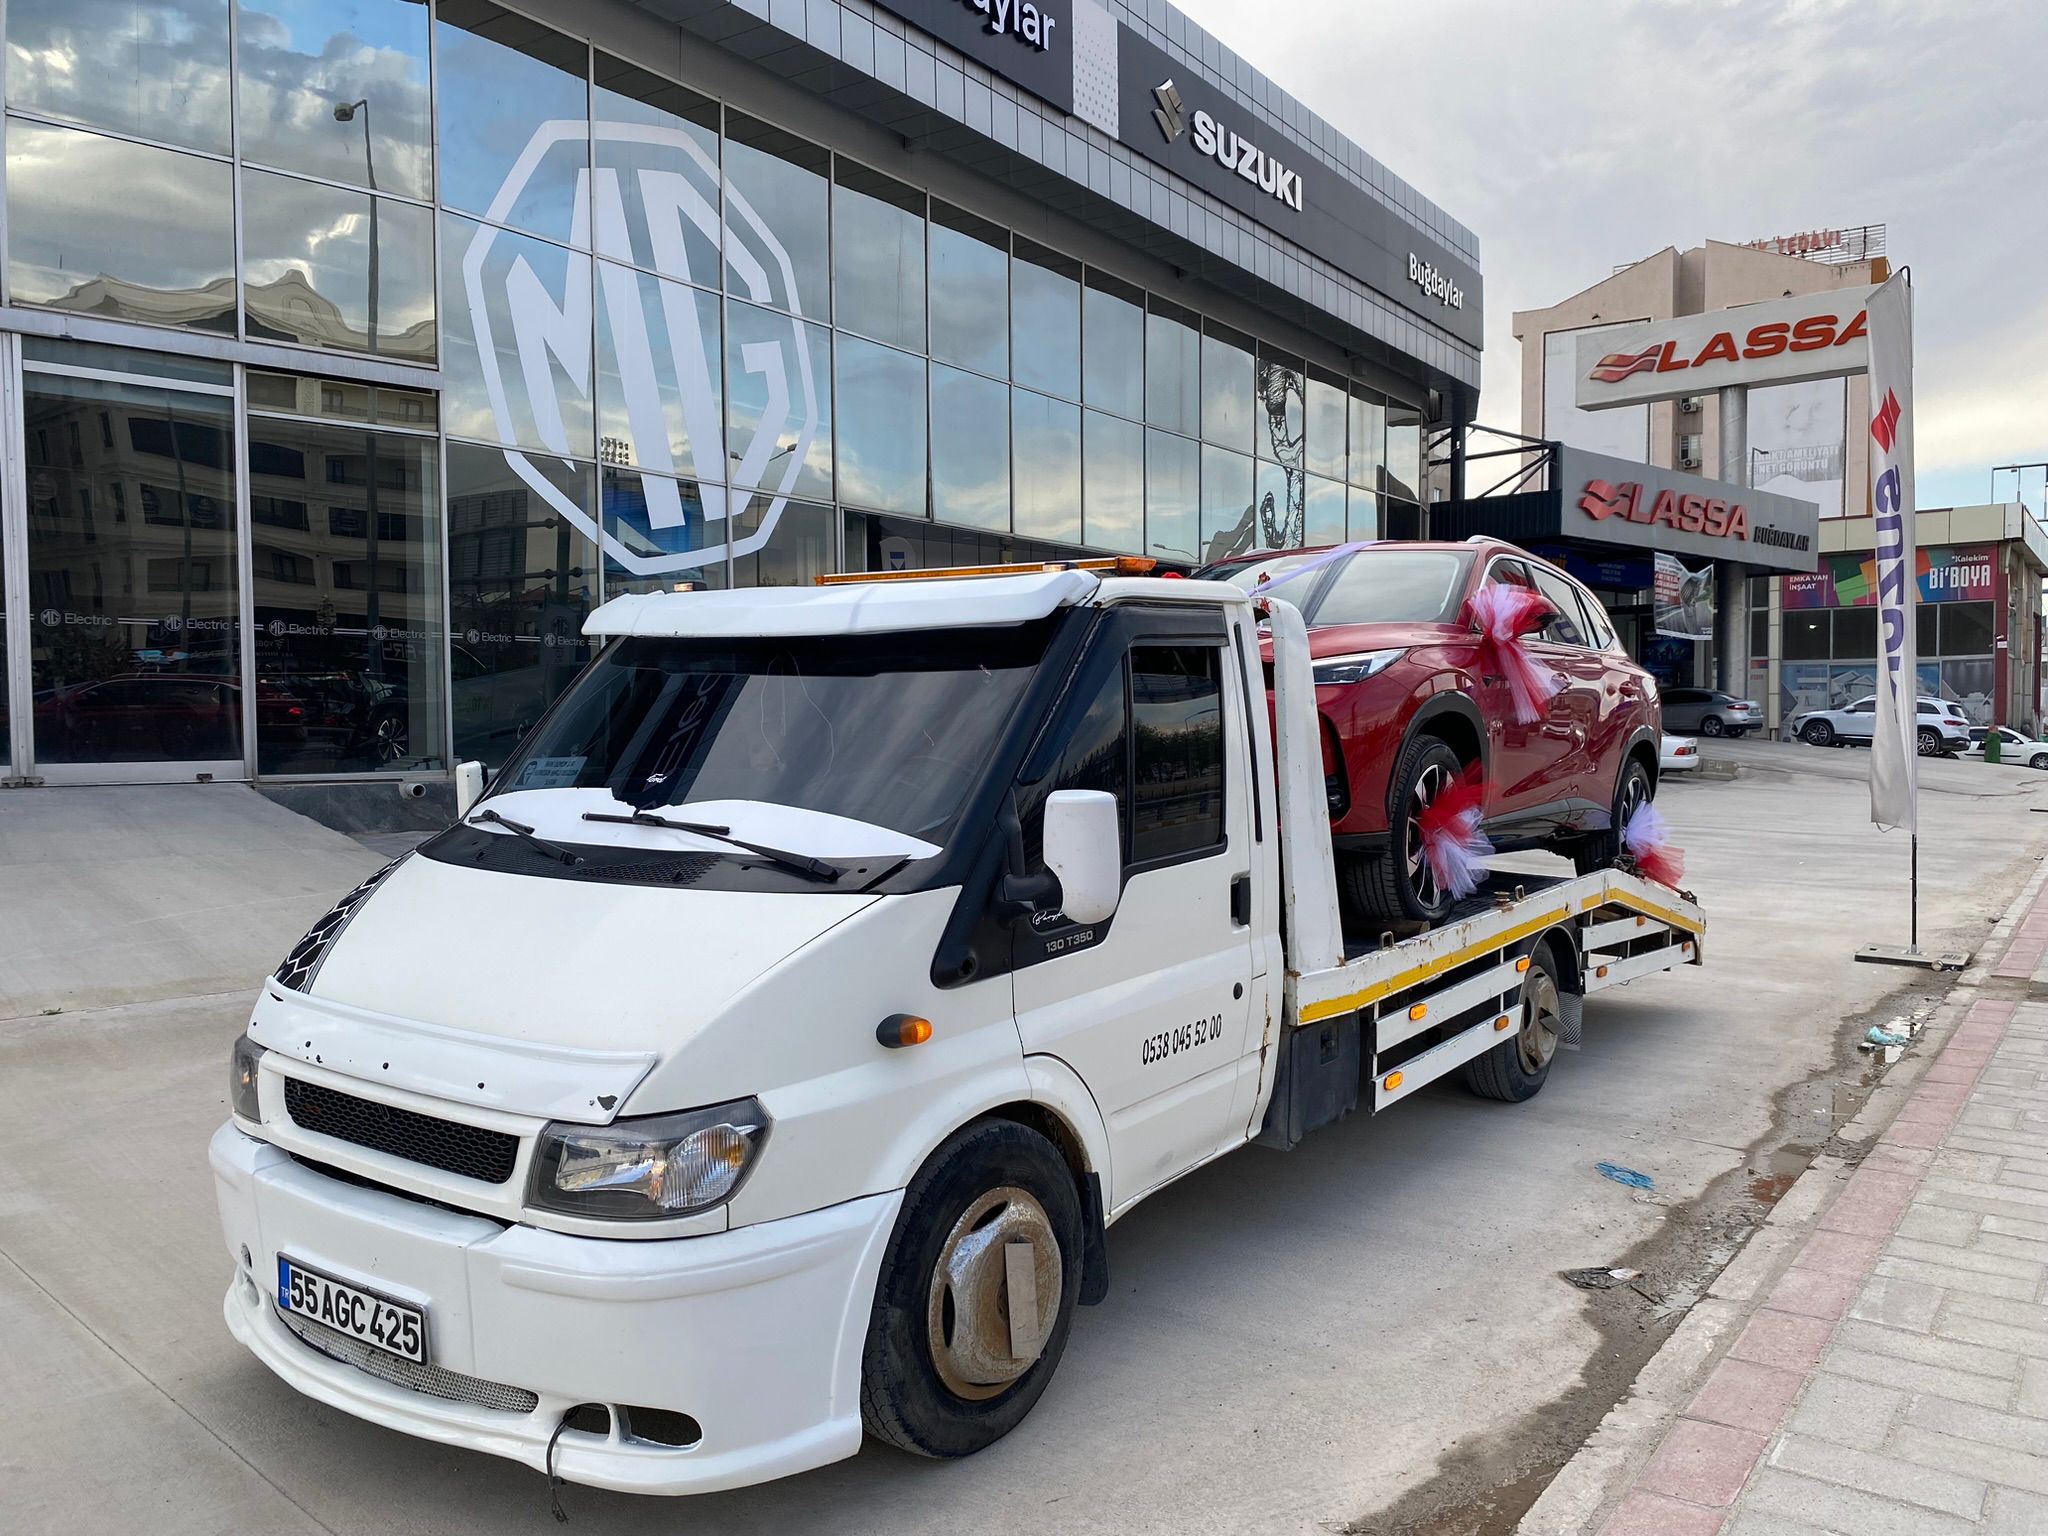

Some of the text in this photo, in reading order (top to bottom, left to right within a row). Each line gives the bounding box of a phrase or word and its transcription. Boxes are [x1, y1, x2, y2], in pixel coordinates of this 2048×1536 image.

[1193, 109, 1303, 212] SUZUKI
[1408, 252, 1464, 310] Buğdaylar
[504, 167, 790, 530] MG
[1656, 309, 1867, 374] LASSA
[1626, 481, 1749, 541] LASSA
[64, 613, 113, 626] Electric
[186, 618, 230, 631] Electric
[289, 623, 329, 636] Electric
[390, 628, 427, 640] Electric
[481, 631, 513, 643] Electric
[1045, 930, 1094, 953] 130 T350
[1142, 1013, 1222, 1066] 0538 045 52 00
[290, 1268, 319, 1315] 55
[321, 1283, 366, 1335] AGC
[369, 1302, 420, 1356] 425
